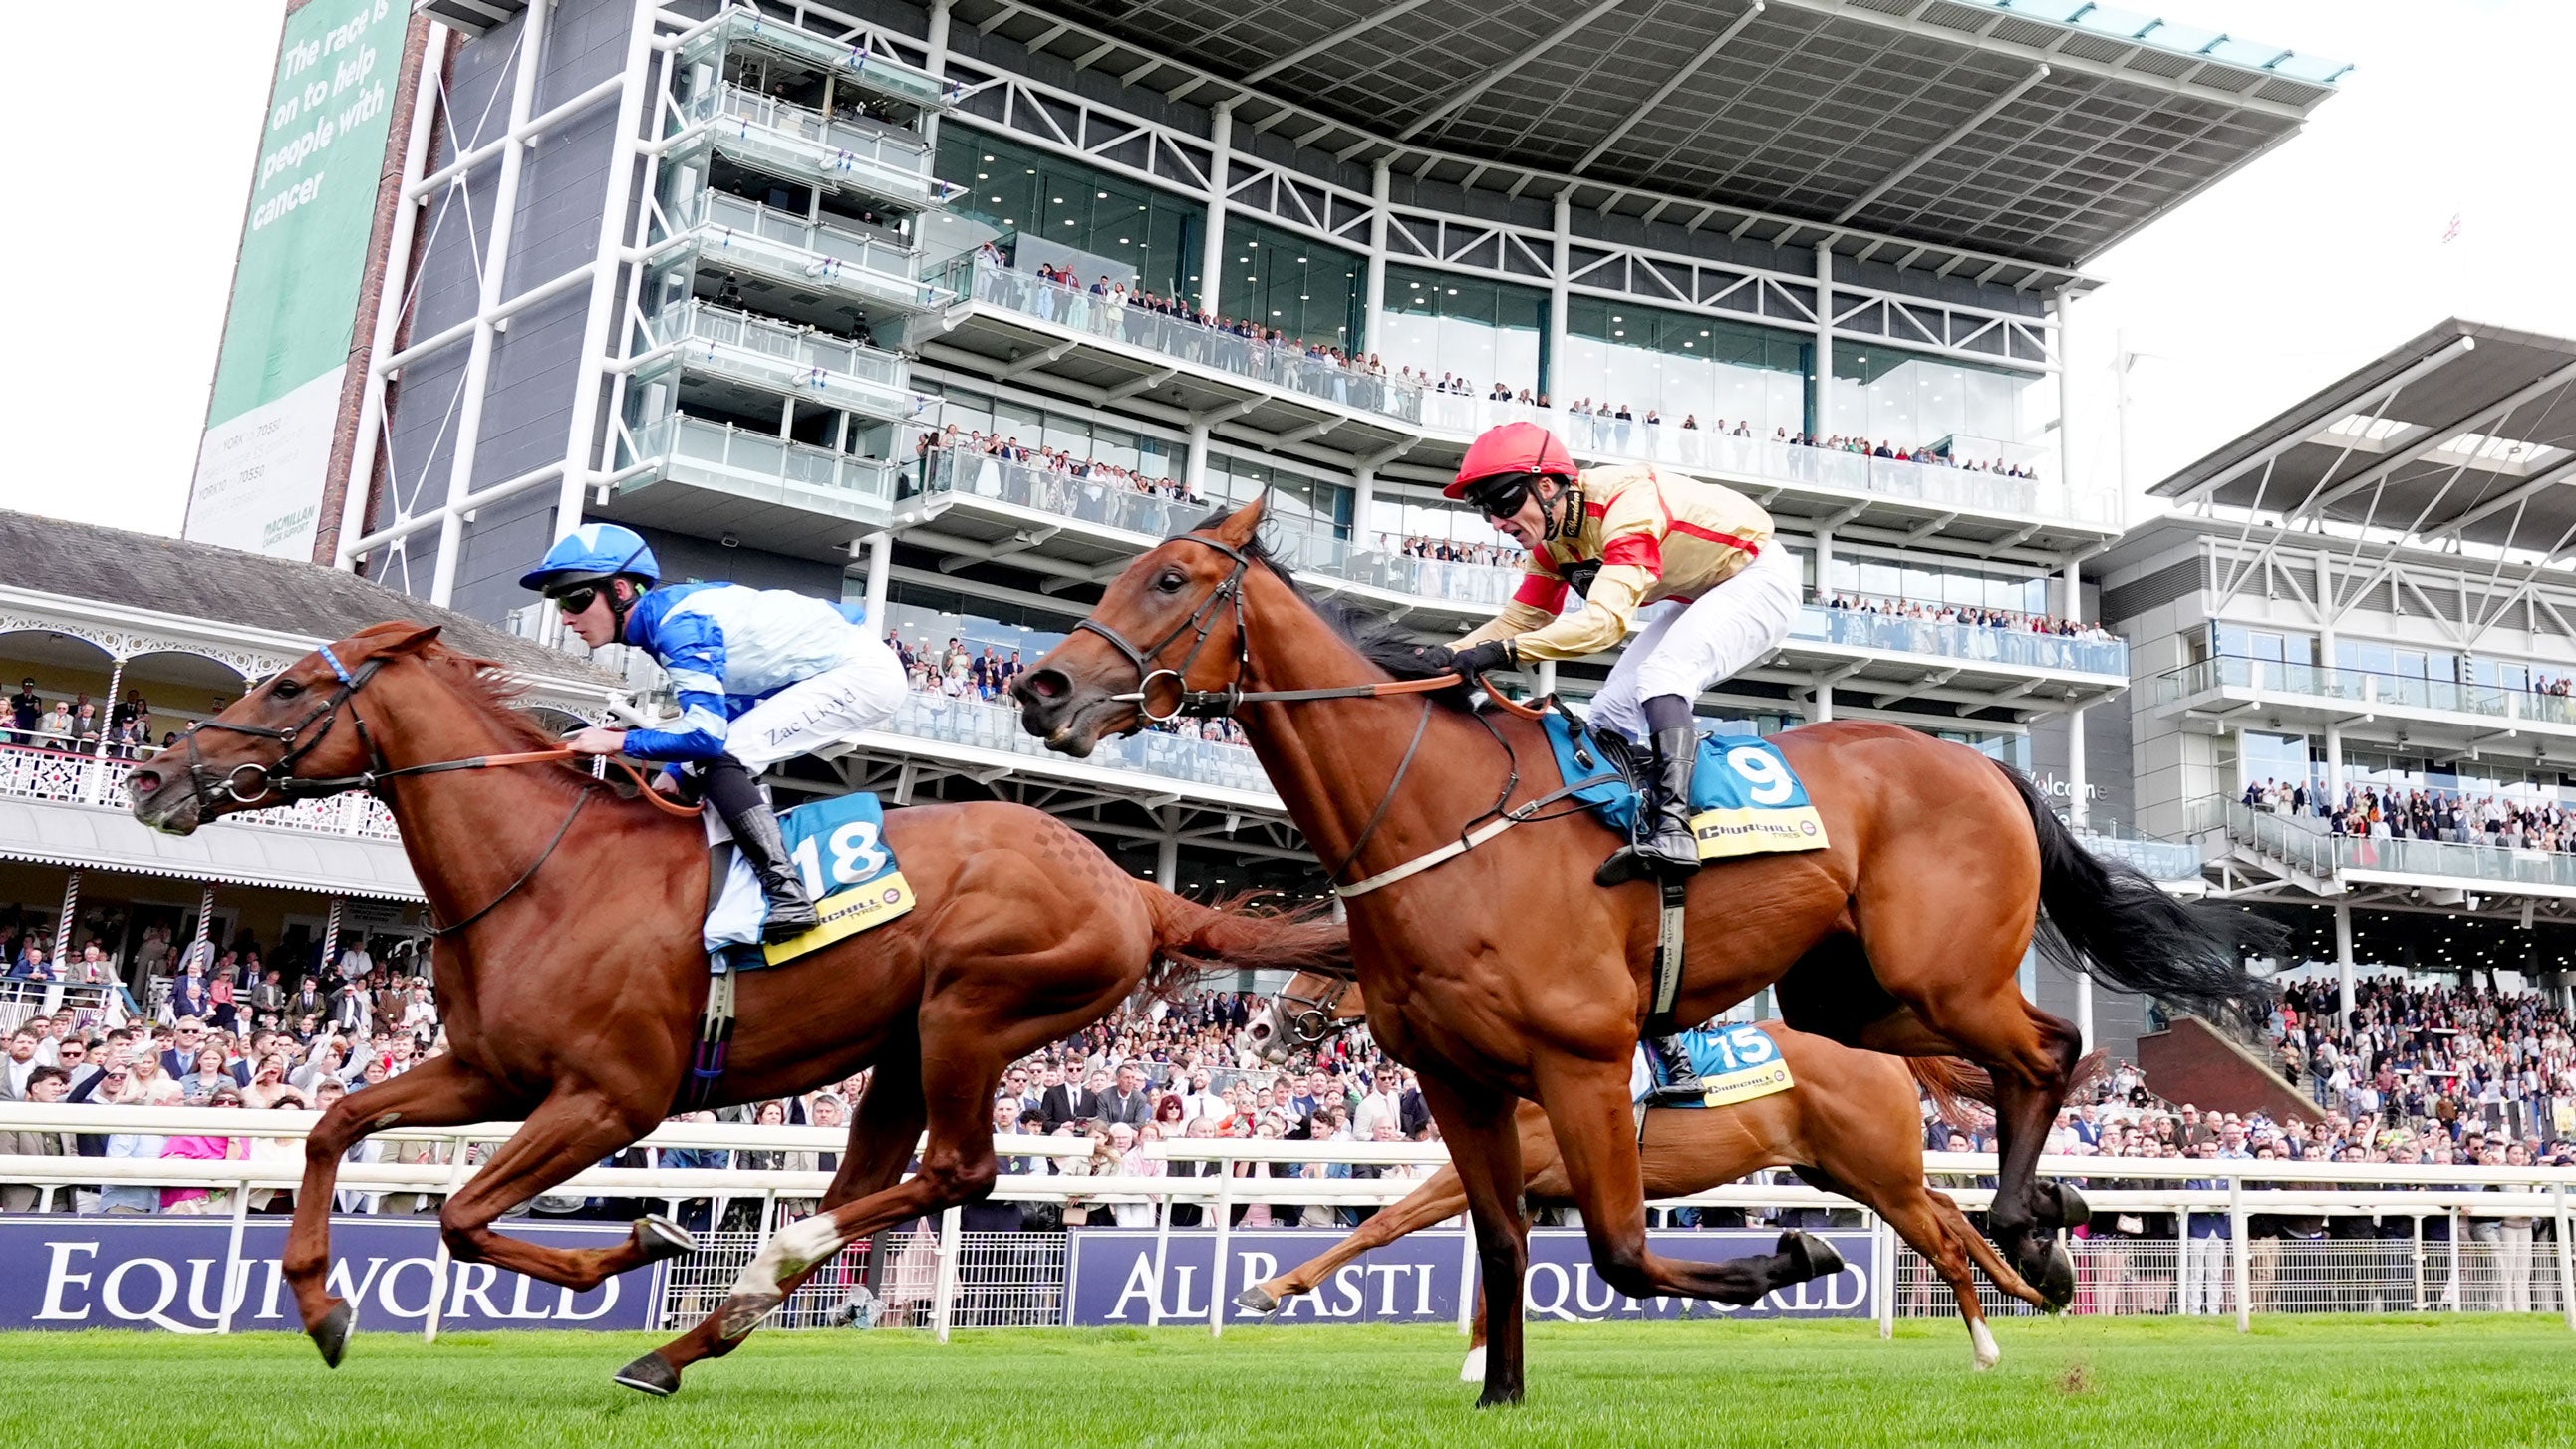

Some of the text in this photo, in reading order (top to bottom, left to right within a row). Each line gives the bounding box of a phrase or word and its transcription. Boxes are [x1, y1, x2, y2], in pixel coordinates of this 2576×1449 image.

[285, 0, 389, 80] The race is
[273, 43, 376, 131] on to help
[260, 79, 385, 190] people with
[252, 171, 325, 231] cancer
[264, 504, 315, 538] MACMILLAN
[763, 688, 856, 746] Zac Lloyd
[1727, 746, 1792, 804] 9
[1698, 824, 1796, 840] CHURCHILL
[792, 821, 886, 904] 18
[1706, 1026, 1773, 1069] 15
[1104, 1251, 1209, 1319] AL
